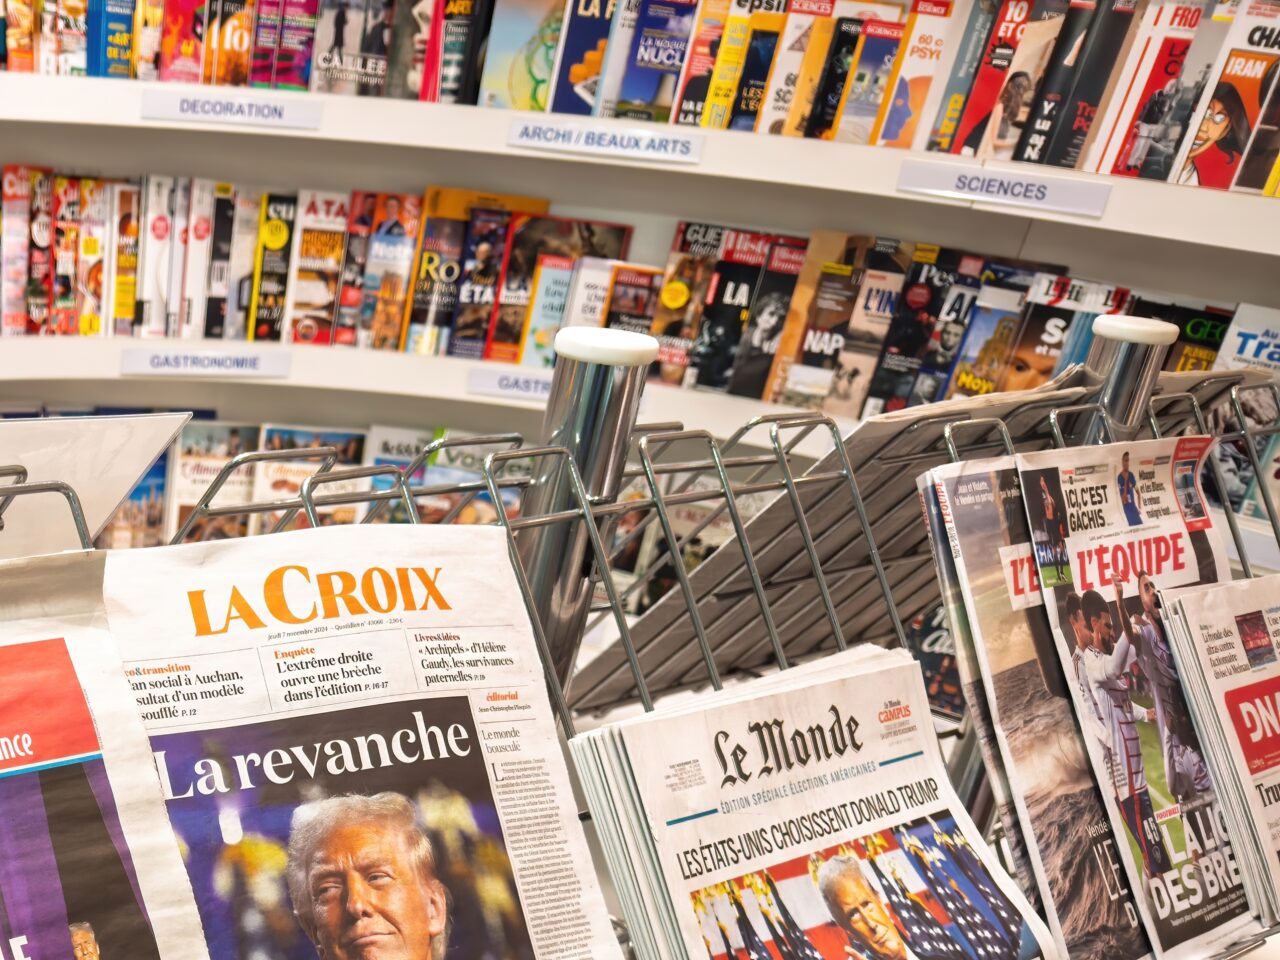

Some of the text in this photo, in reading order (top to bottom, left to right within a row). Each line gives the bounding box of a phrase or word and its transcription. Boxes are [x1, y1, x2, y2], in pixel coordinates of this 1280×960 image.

[1224, 56, 1268, 79] IRAN
[179, 98, 284, 119] DECORATION
[518, 125, 690, 155] ARCHI BEAUX ARTS
[954, 174, 1047, 200] SCIENCES
[149, 354, 259, 369] GASTRONOMIE
[1064, 484, 1108, 510] ICI, C'EST
[1065, 508, 1105, 532] GÂCHIS
[1077, 531, 1185, 592] L'ÉQUIPE
[187, 564, 452, 637] LA CROIX
[273, 646, 314, 659] Enquête
[420, 641, 506, 657] Archipels d'Hélène
[276, 650, 372, 673] L'extrême droite
[420, 656, 513, 671] Gaudy, les survivances
[148, 670, 243, 688] social à Auchan,
[280, 663, 381, 687] ouvre une brèche
[424, 670, 473, 686] paternelles
[171, 683, 244, 702] d'un modèle
[283, 682, 362, 702] dans l'édition
[153, 710, 471, 800] La revanche
[713, 729, 754, 790] Le
[748, 704, 865, 778] Monde
[720, 760, 875, 814] ÉDITION SPÉCIALE ÉLECTIONS AMÉRICAINES
[676, 777, 938, 880] LES ÉTATS-UNIS CHOISISSENT DONALD TRUMP
[1149, 867, 1203, 920] DES
